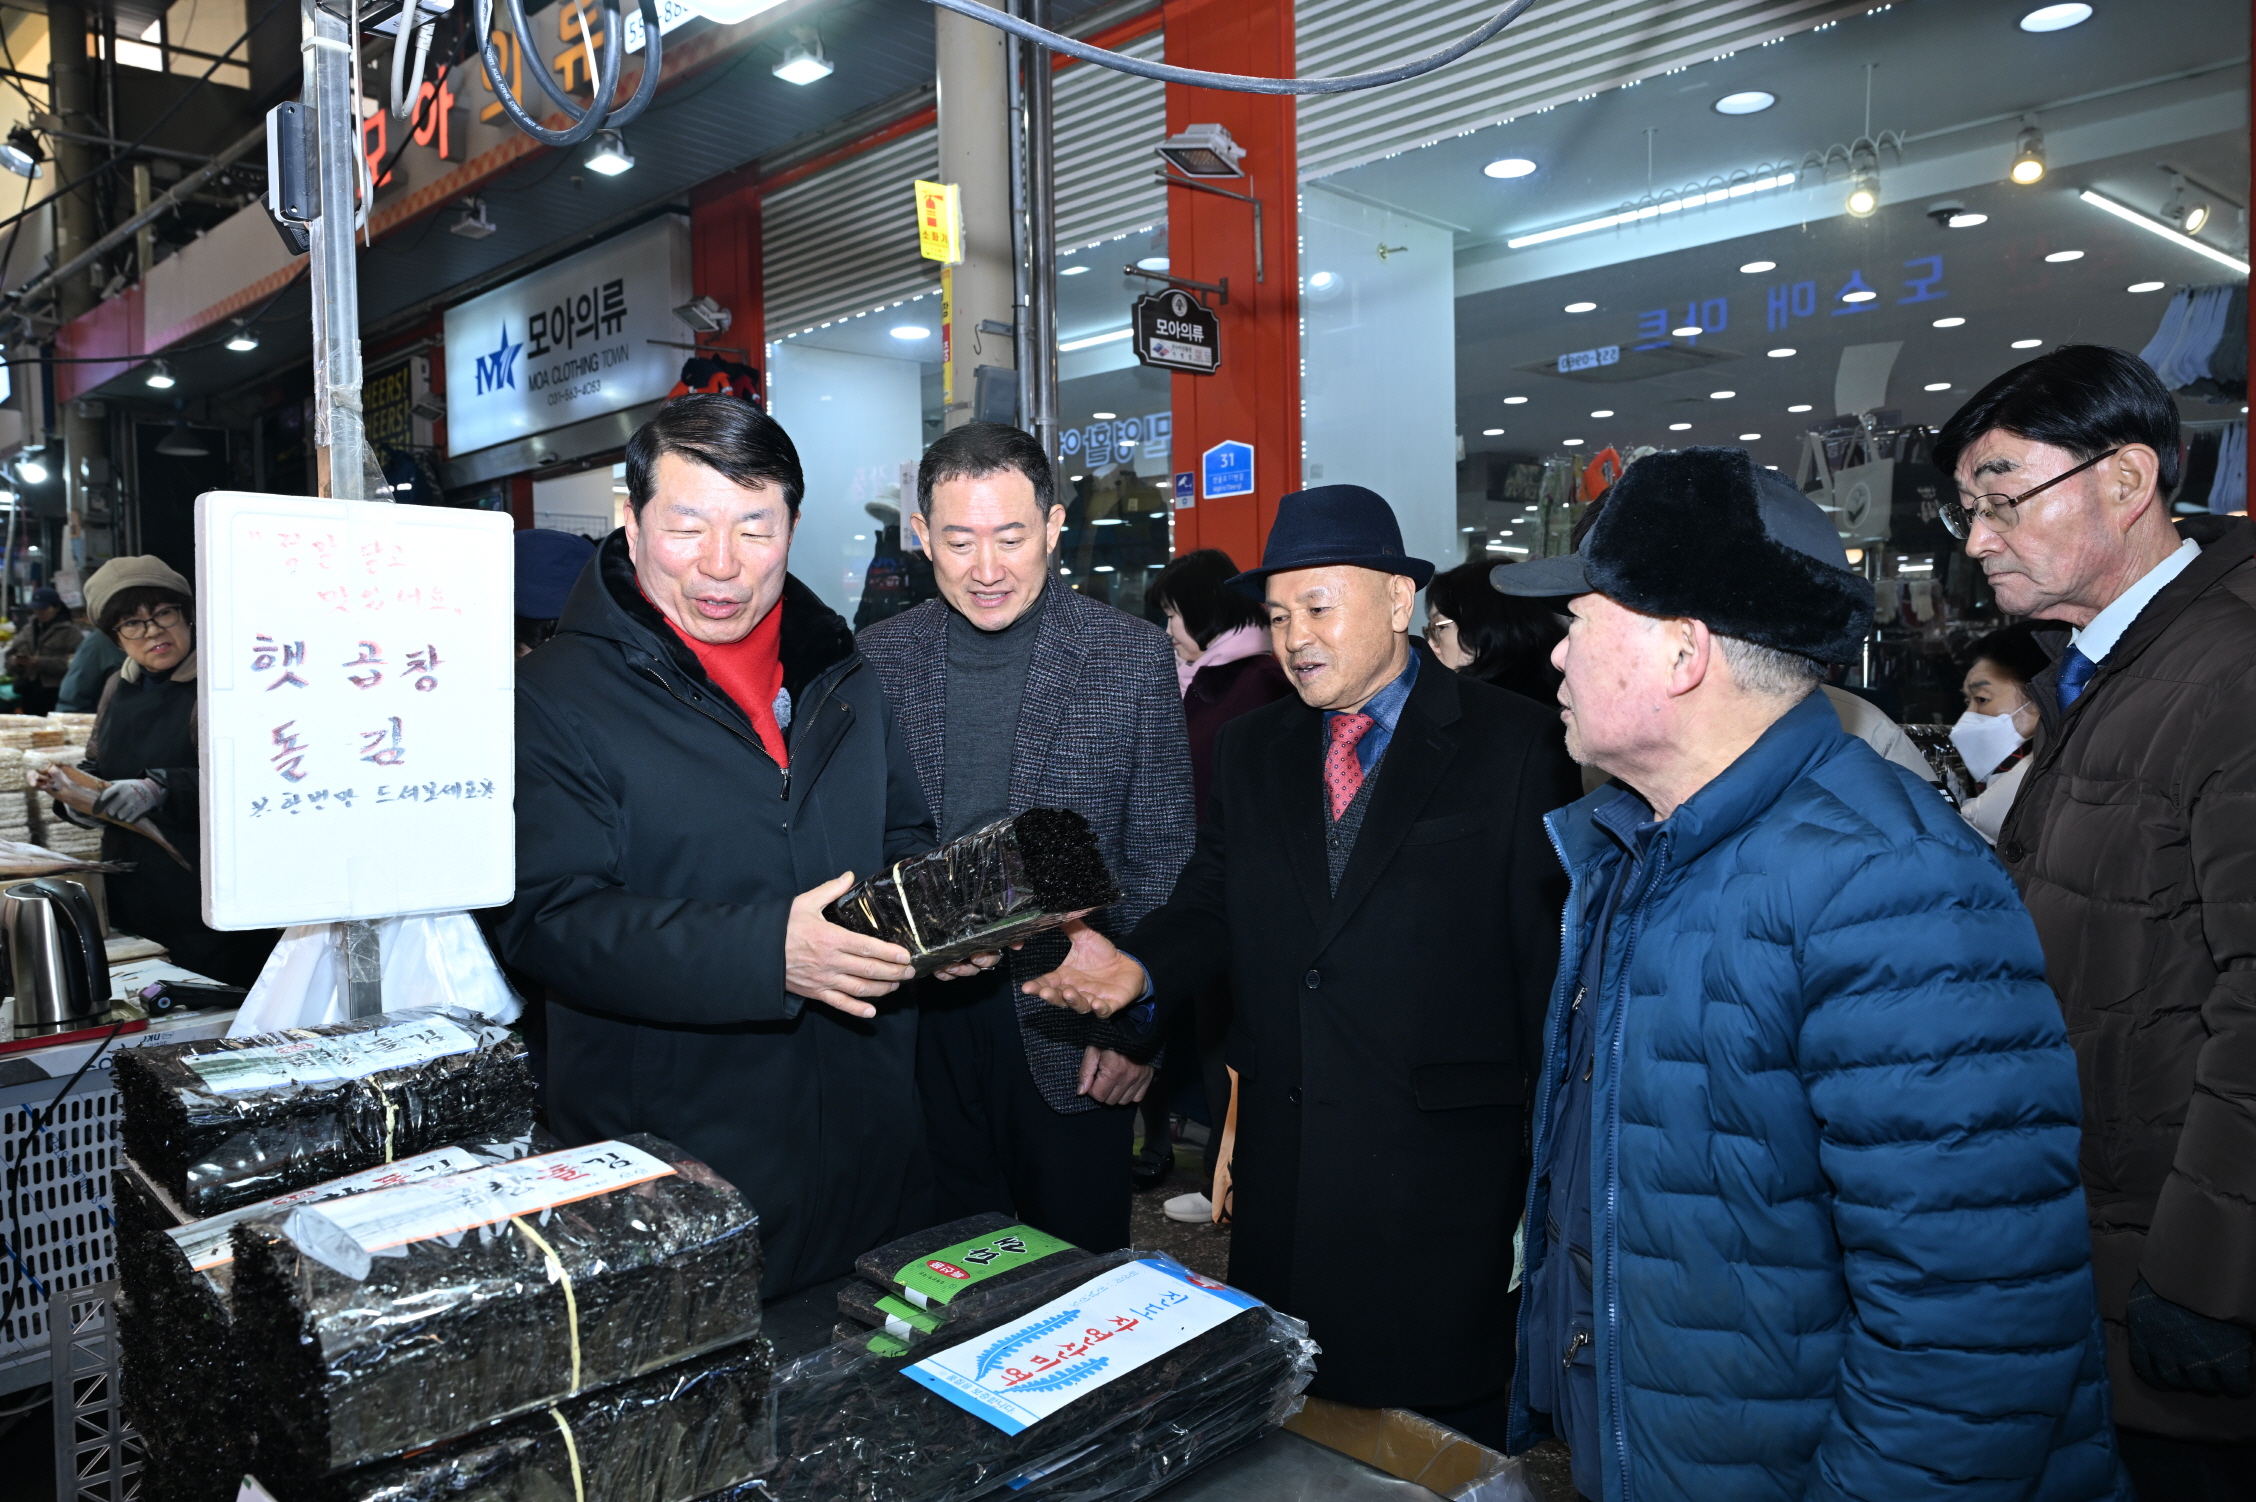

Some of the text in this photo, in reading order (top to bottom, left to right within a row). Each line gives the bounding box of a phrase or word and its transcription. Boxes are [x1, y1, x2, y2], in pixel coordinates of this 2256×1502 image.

[922, 230, 948, 244] 소화기
[527, 278, 628, 360] 모아의류
[1155, 318, 1205, 343] 모아의류
[528, 343, 629, 393] MOA CLOTHING TOWN
[363, 367, 409, 413] HEERS!
[364, 398, 410, 441] HEERS!
[1220, 452, 1235, 468] 31
[250, 632, 445, 692] 햇 곱창
[1130, 1290, 1189, 1321] 진도
